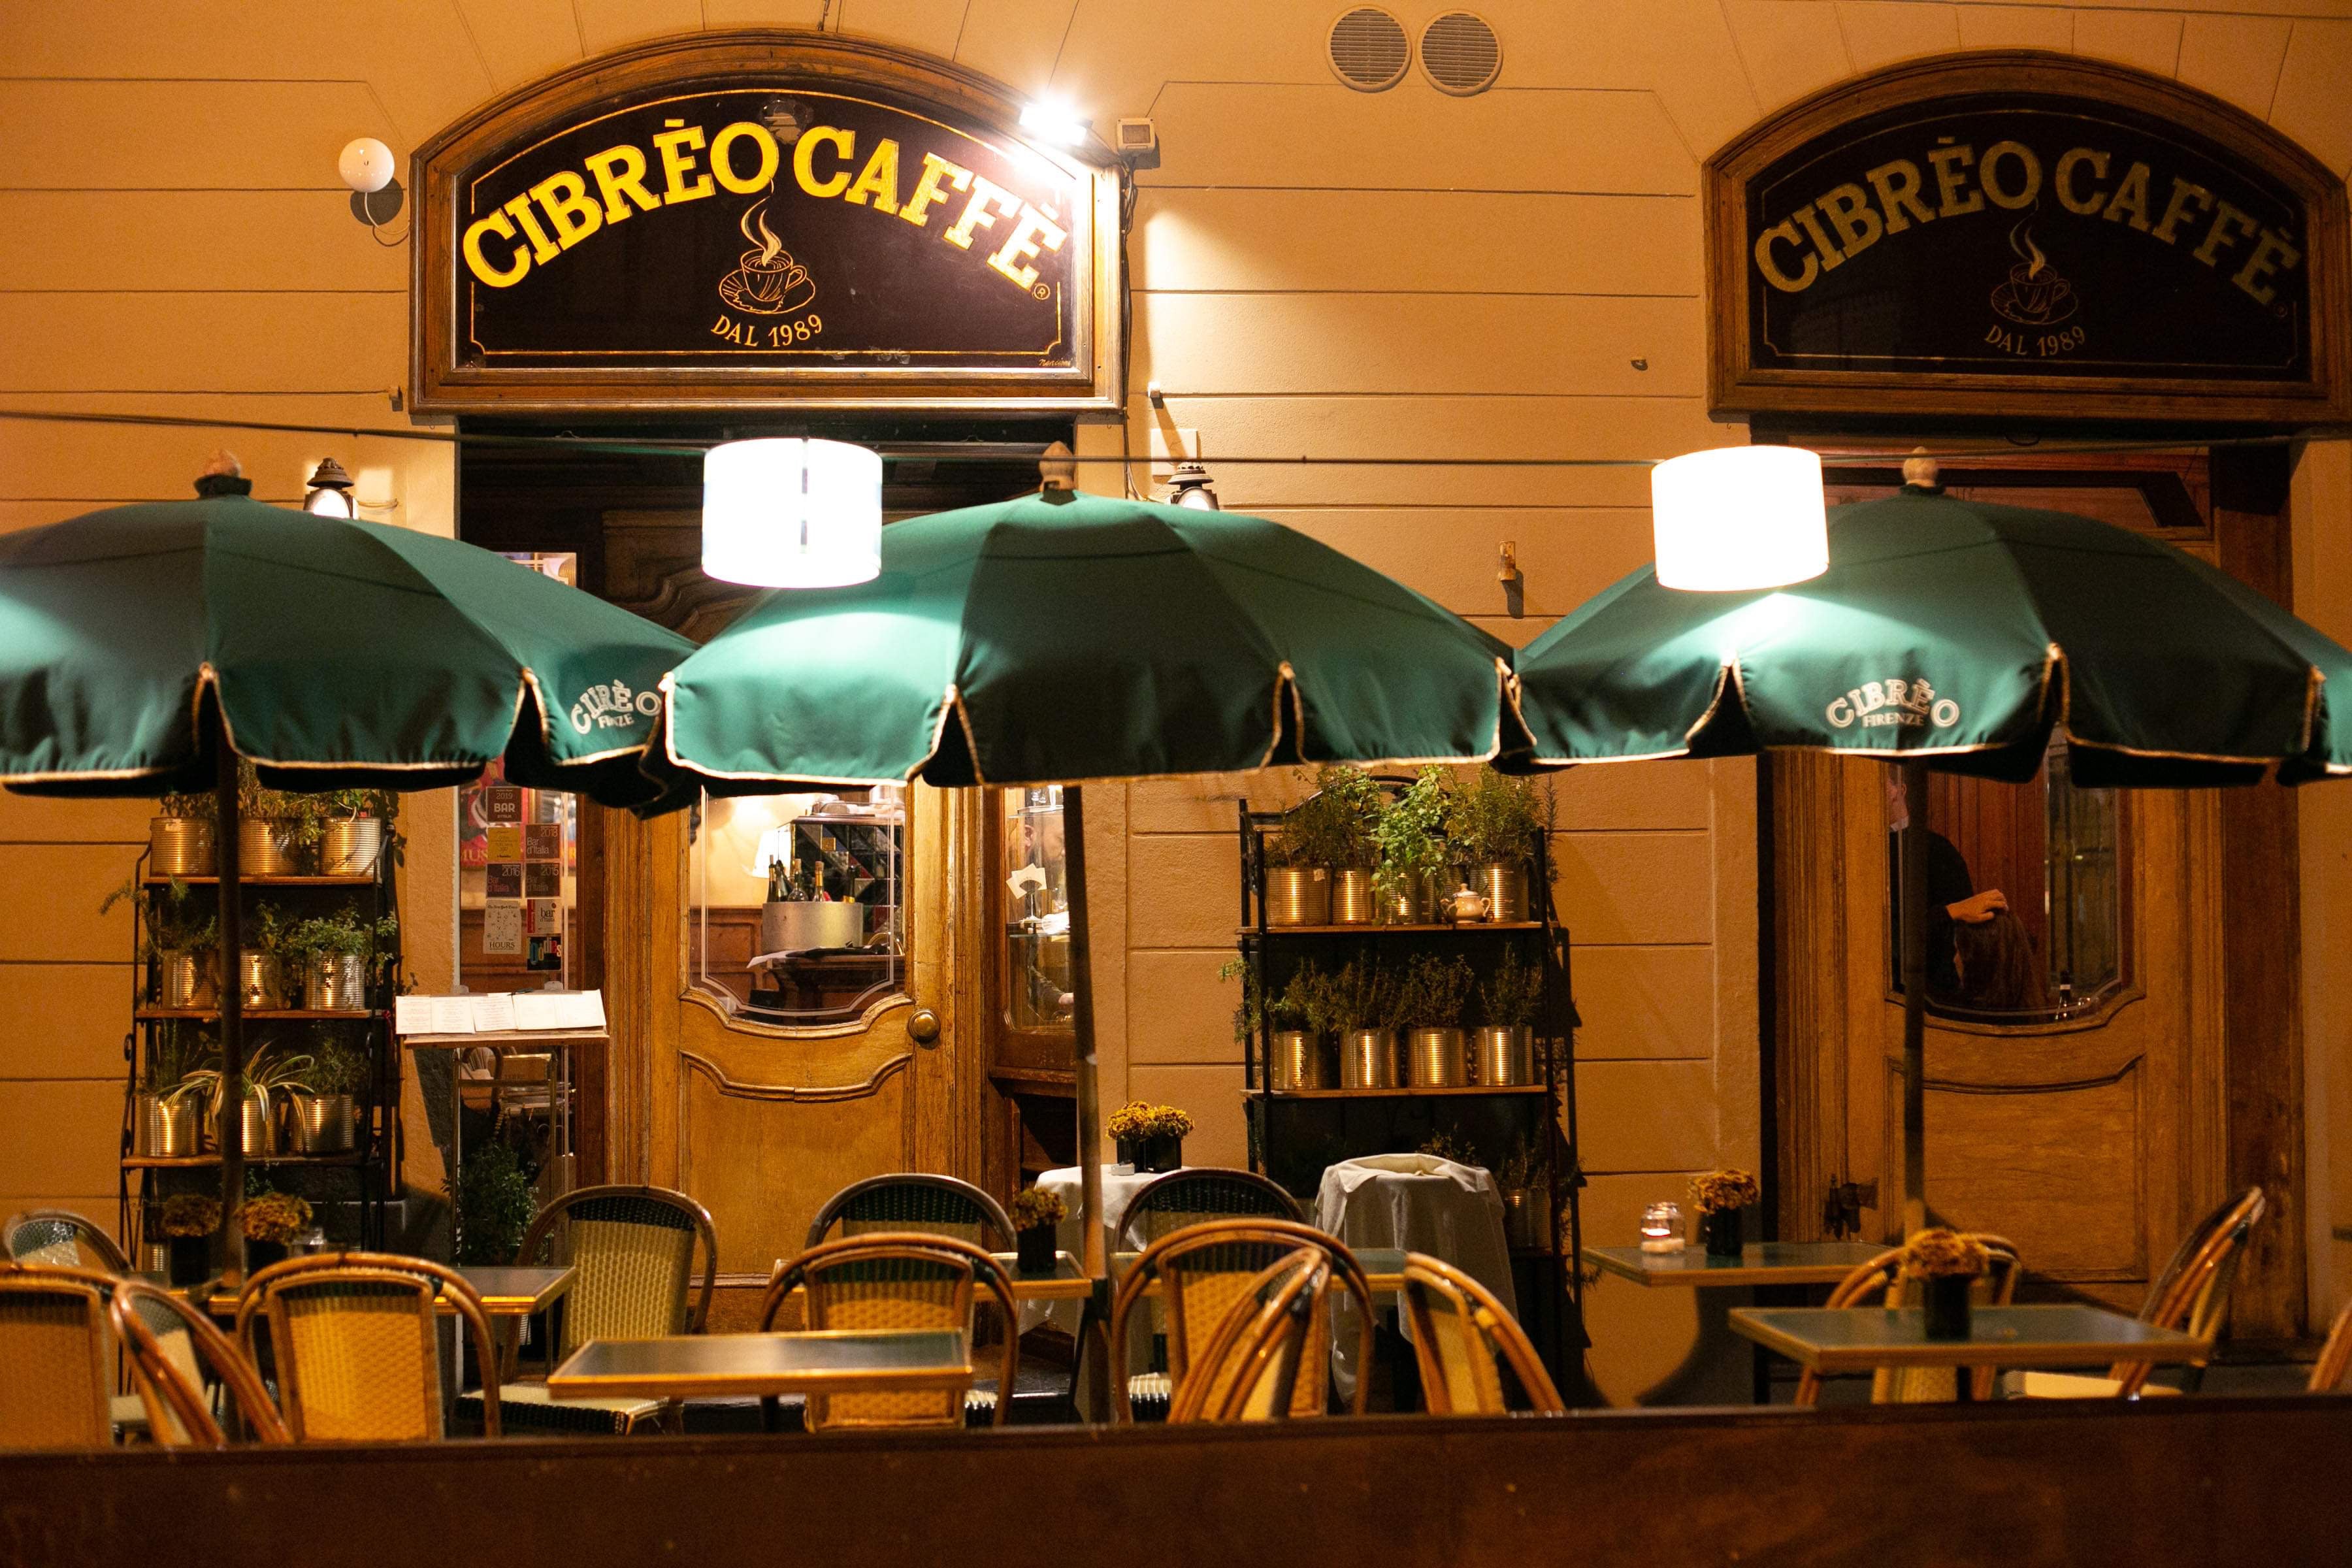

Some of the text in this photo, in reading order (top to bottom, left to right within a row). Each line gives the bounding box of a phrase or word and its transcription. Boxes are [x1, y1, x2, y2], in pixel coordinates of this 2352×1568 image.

[710, 314, 822, 347] DAL 1989
[1984, 325, 2085, 357] DAL 1989
[1863, 712, 1925, 728] FIRENZE
[493, 803, 515, 813] BAR
[527, 837, 540, 846] Bar
[527, 845, 549, 855] d'Italia
[502, 866, 521, 876] 2016
[541, 866, 559, 876] 2015
[487, 875, 499, 884] Bar
[541, 907, 555, 917] bar
